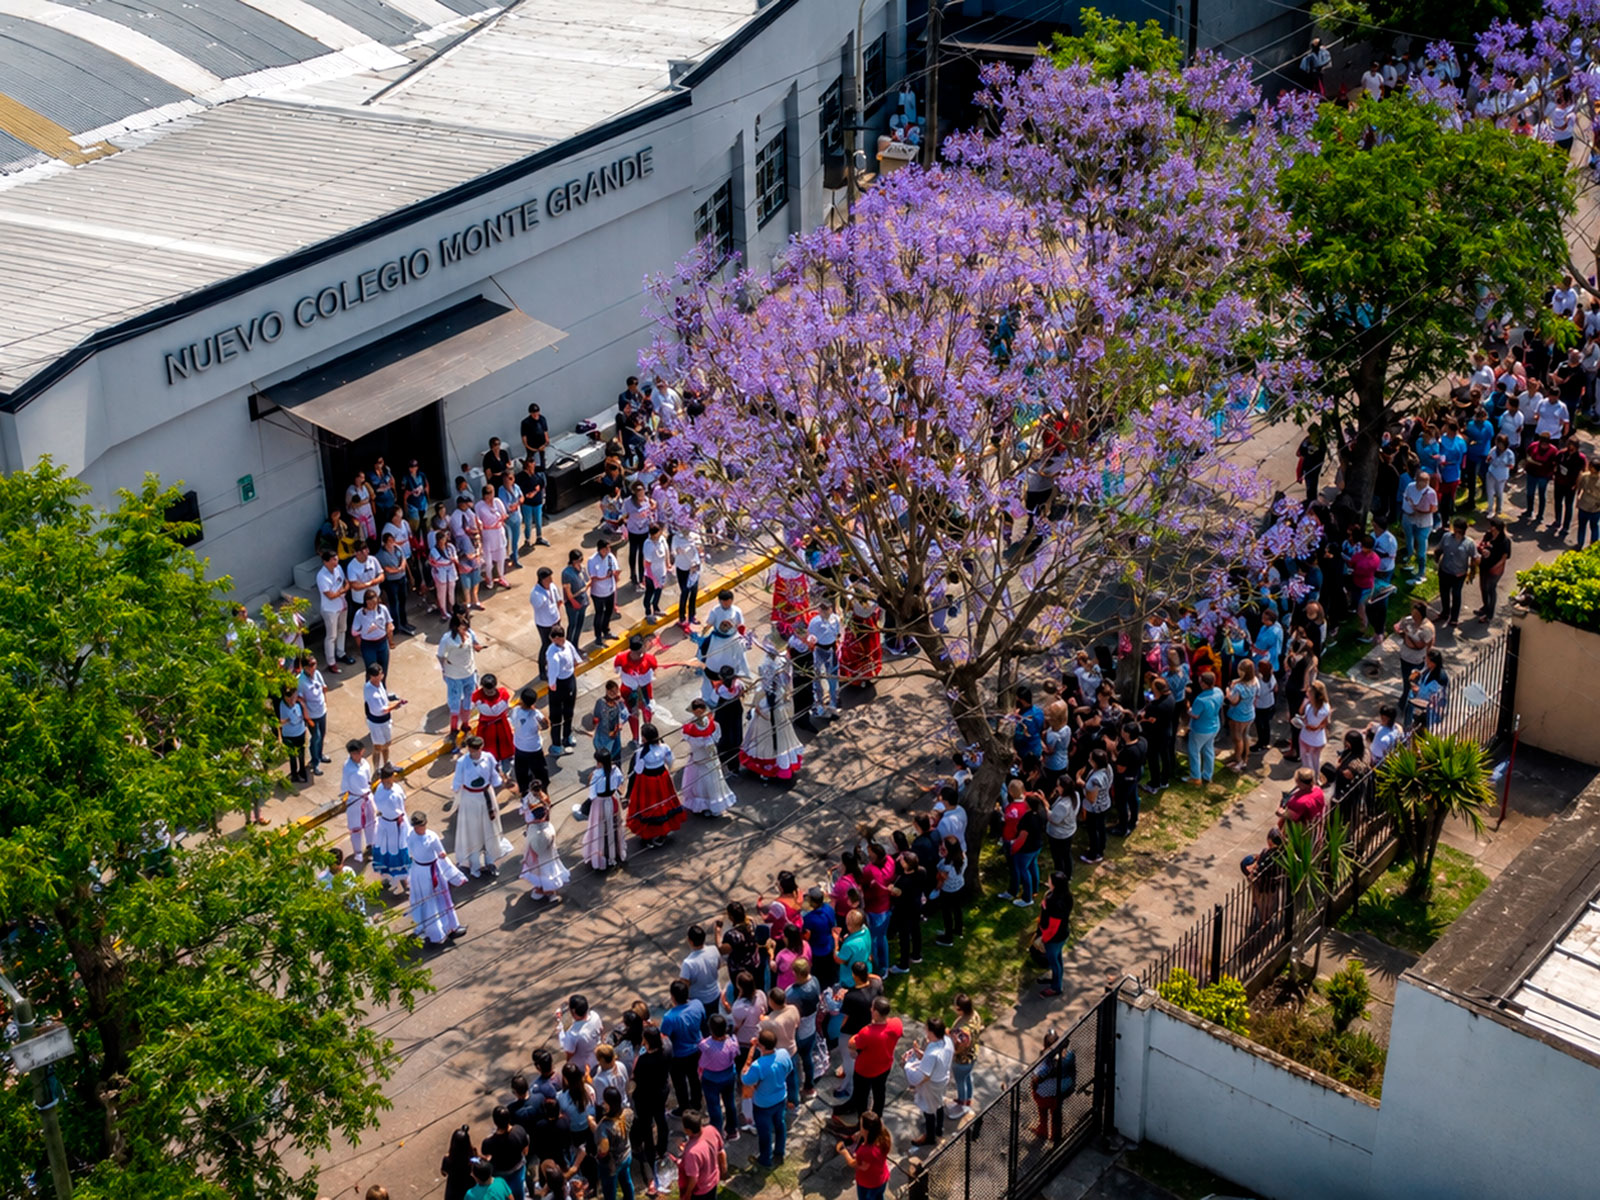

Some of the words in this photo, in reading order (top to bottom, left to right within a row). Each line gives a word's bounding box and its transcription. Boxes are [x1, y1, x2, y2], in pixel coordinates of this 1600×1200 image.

[164, 310, 285, 386] NUEVO
[294, 249, 432, 328] COLEGIO
[439, 198, 540, 268] MONTE
[546, 146, 654, 218] GRANDE
